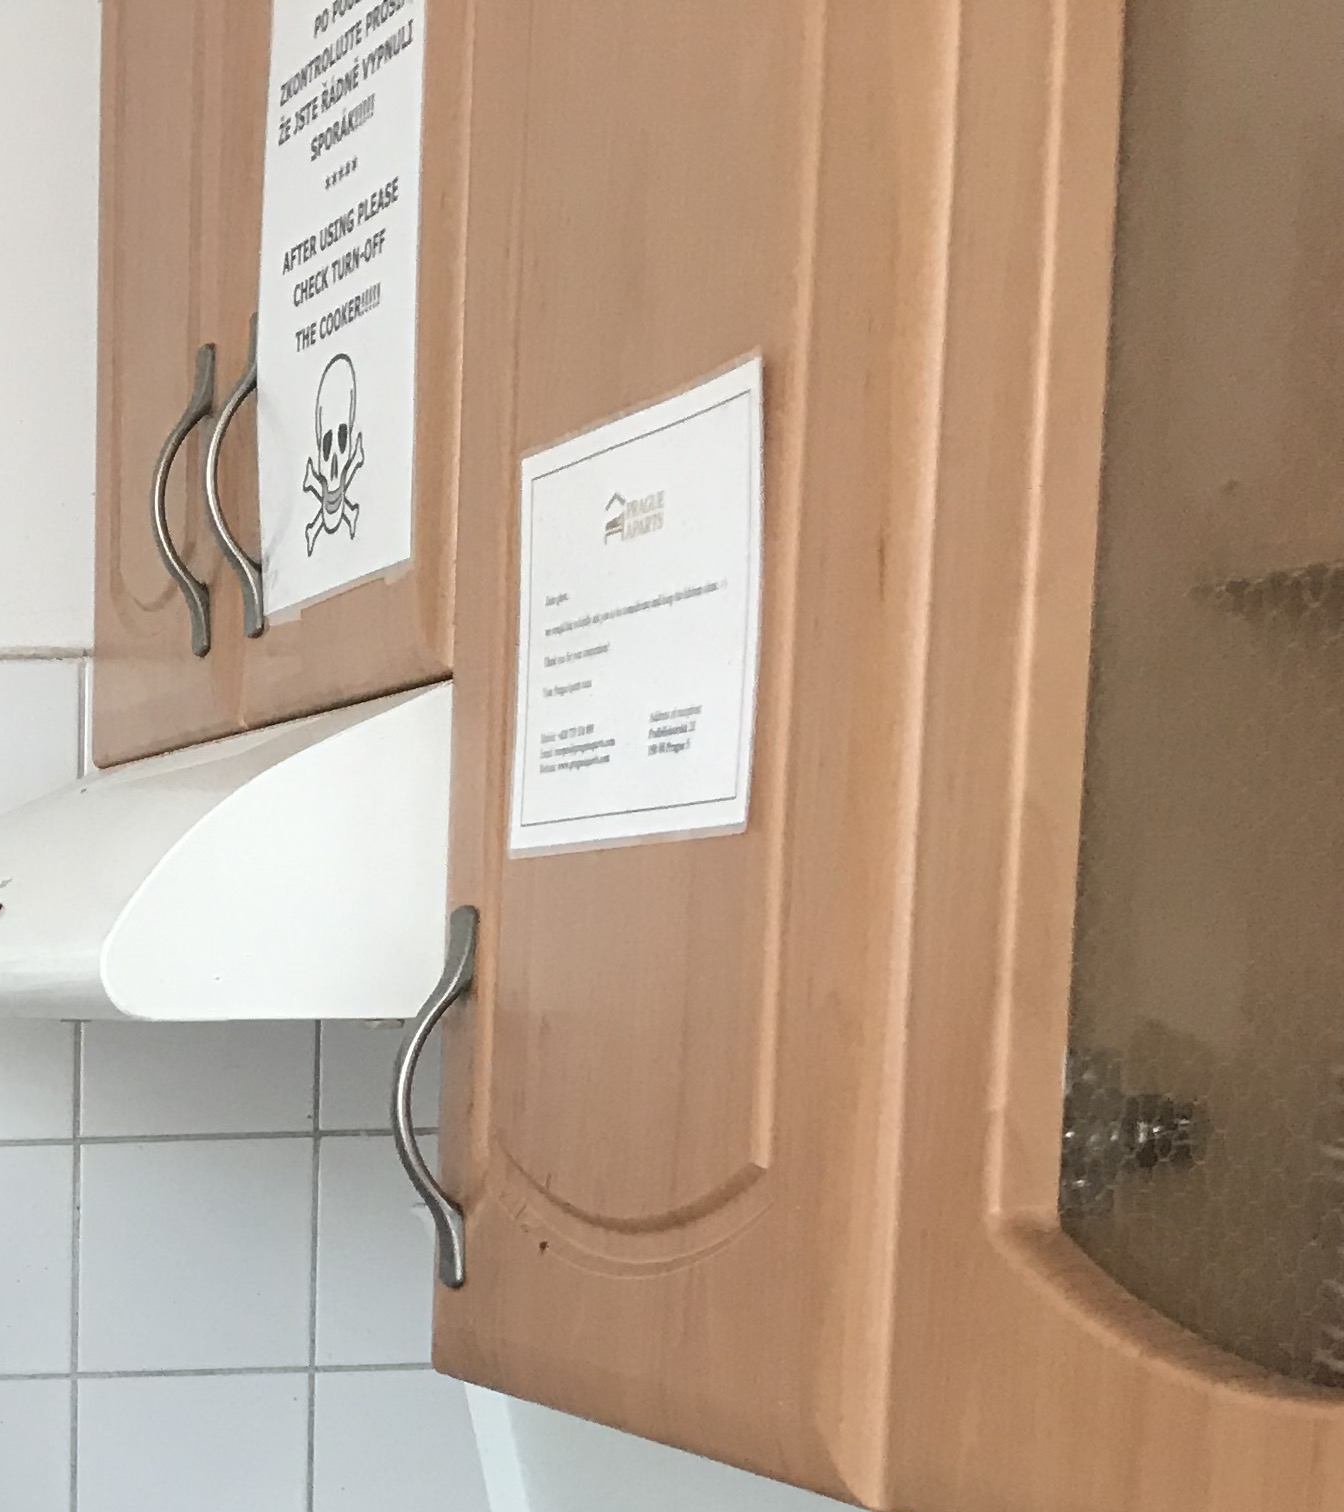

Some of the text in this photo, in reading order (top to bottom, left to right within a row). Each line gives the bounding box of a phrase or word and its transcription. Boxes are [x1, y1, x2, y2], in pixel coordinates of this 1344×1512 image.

[280, 20, 362, 107] ZKONTROLUJTE
[314, 8, 329, 38] PO
[293, 96, 318, 135] JSTE
[362, 19, 413, 80] VYPNULI
[282, 176, 399, 275] AFTER USING PLEASE
[293, 228, 386, 307] CHECK TURN-OFF
[295, 322, 317, 352] THE
